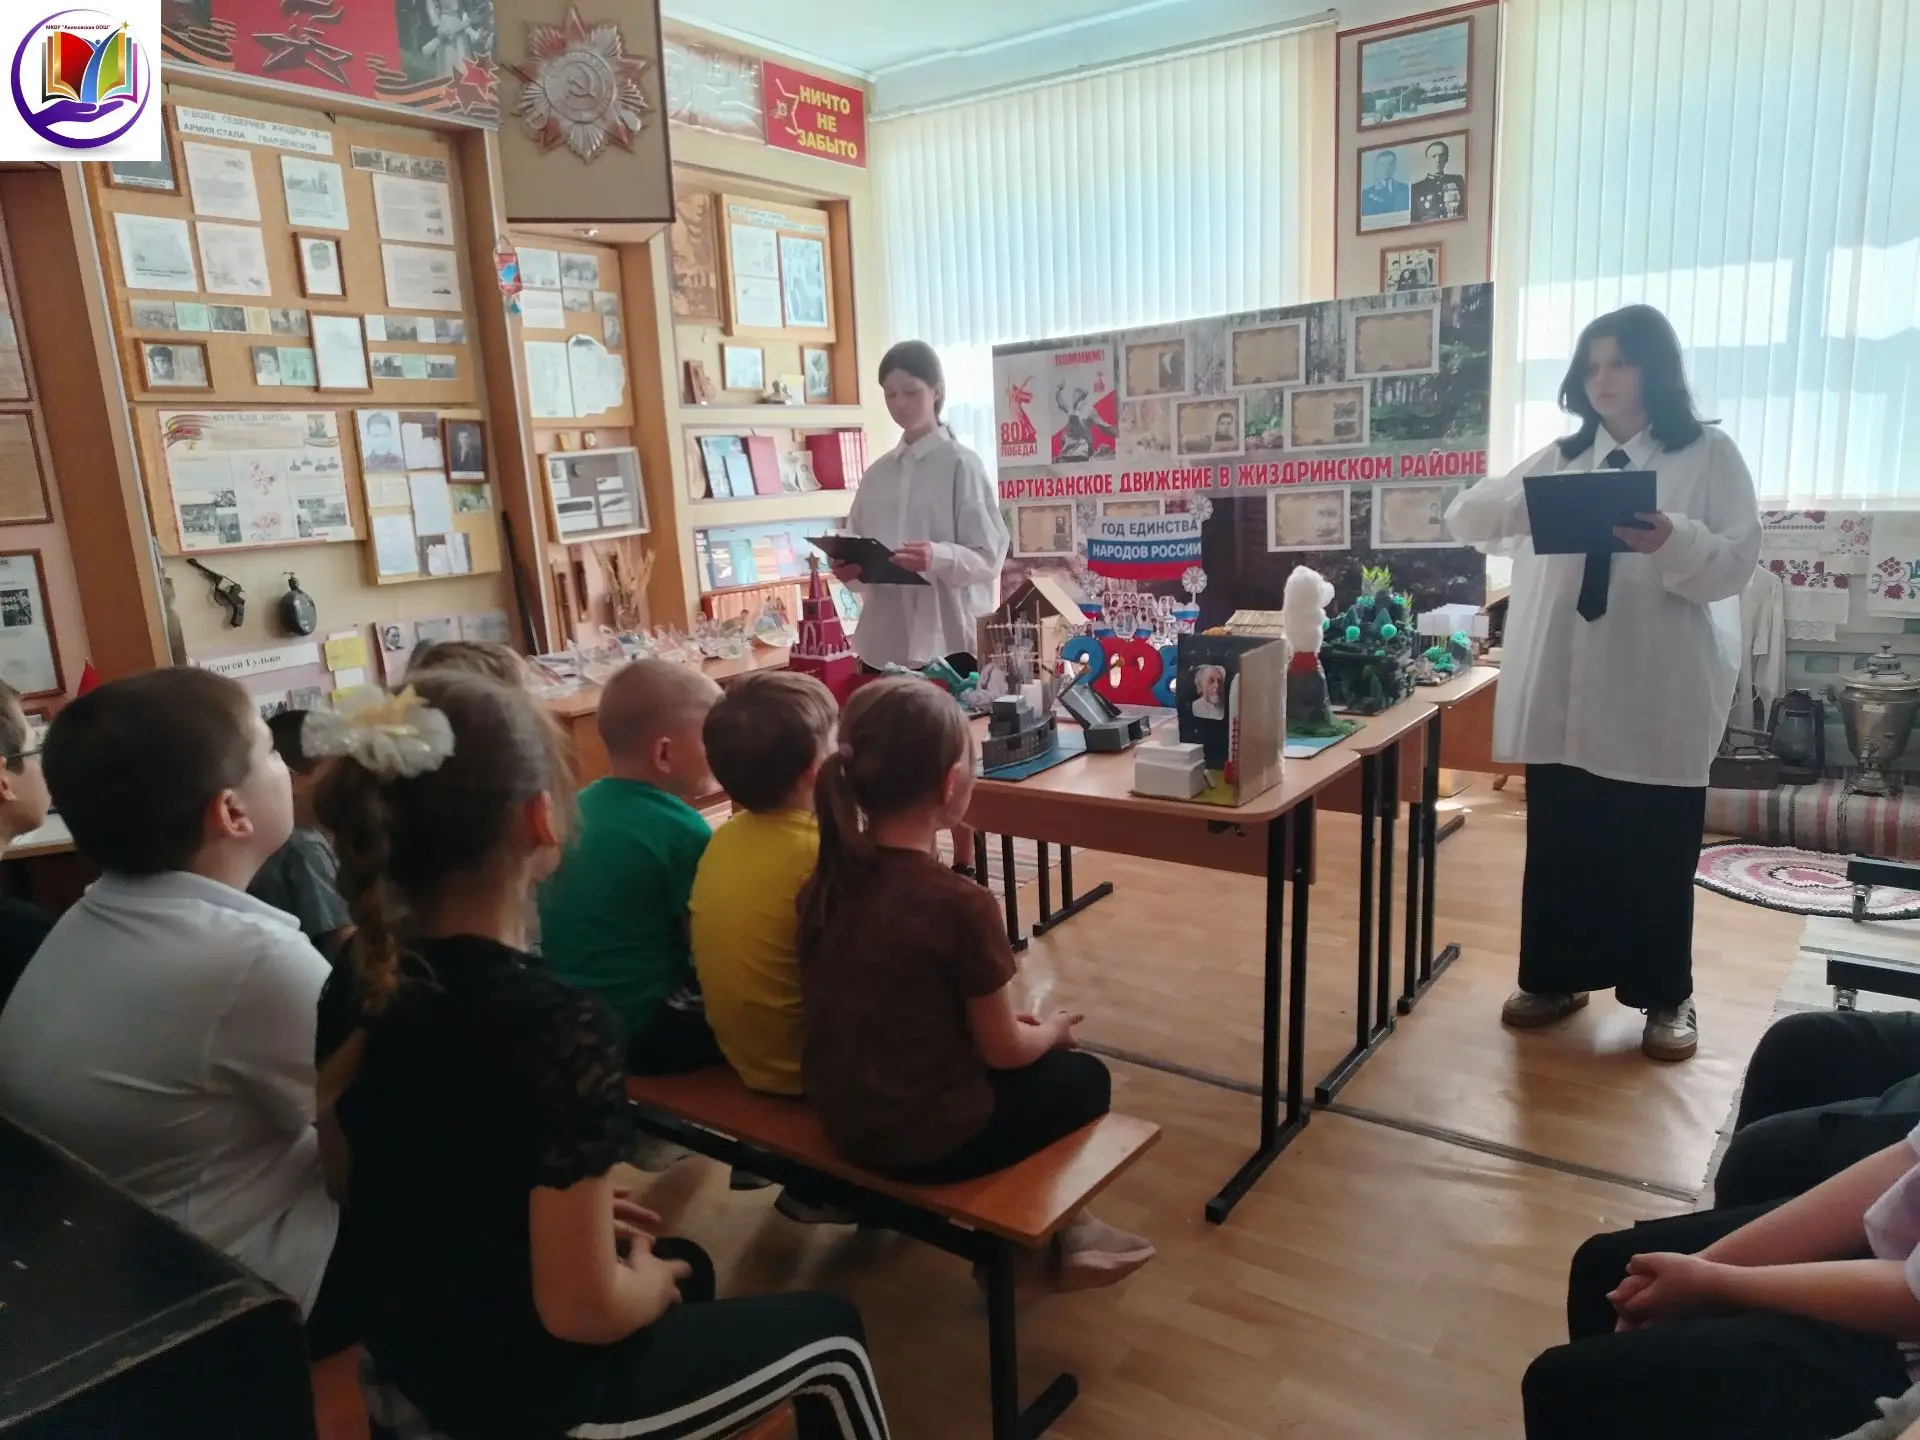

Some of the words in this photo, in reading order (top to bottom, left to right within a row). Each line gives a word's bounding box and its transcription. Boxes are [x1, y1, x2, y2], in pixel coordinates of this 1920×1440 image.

[800, 85, 851, 115] НИЧТО
[183, 123, 215, 135] АРМИЯ
[216, 128, 246, 139] СТАЛА
[816, 112, 837, 132] НЕ
[796, 128, 858, 159] ЗАБЫТО
[1054, 349, 1105, 367] ПОМНИМ!
[1000, 421, 1021, 442] 80
[1001, 443, 1038, 457] ПОБЕДА!
[998, 473, 1113, 500] ПАРТИЗАНСКОЕ
[1118, 466, 1213, 494] ДВИЖЕНИЕ
[1218, 465, 1231, 488] В
[1237, 455, 1392, 487] ЖИЗДРИНСКОМ
[1400, 448, 1487, 478] РАЙОНЕ
[1101, 522, 1125, 537] ГОД
[1129, 519, 1199, 537] ЕДИНСТВА
[1092, 543, 1149, 560] НАРОДОВ
[1151, 542, 1202, 558] РОССИИ
[208, 662, 243, 673] Сергей
